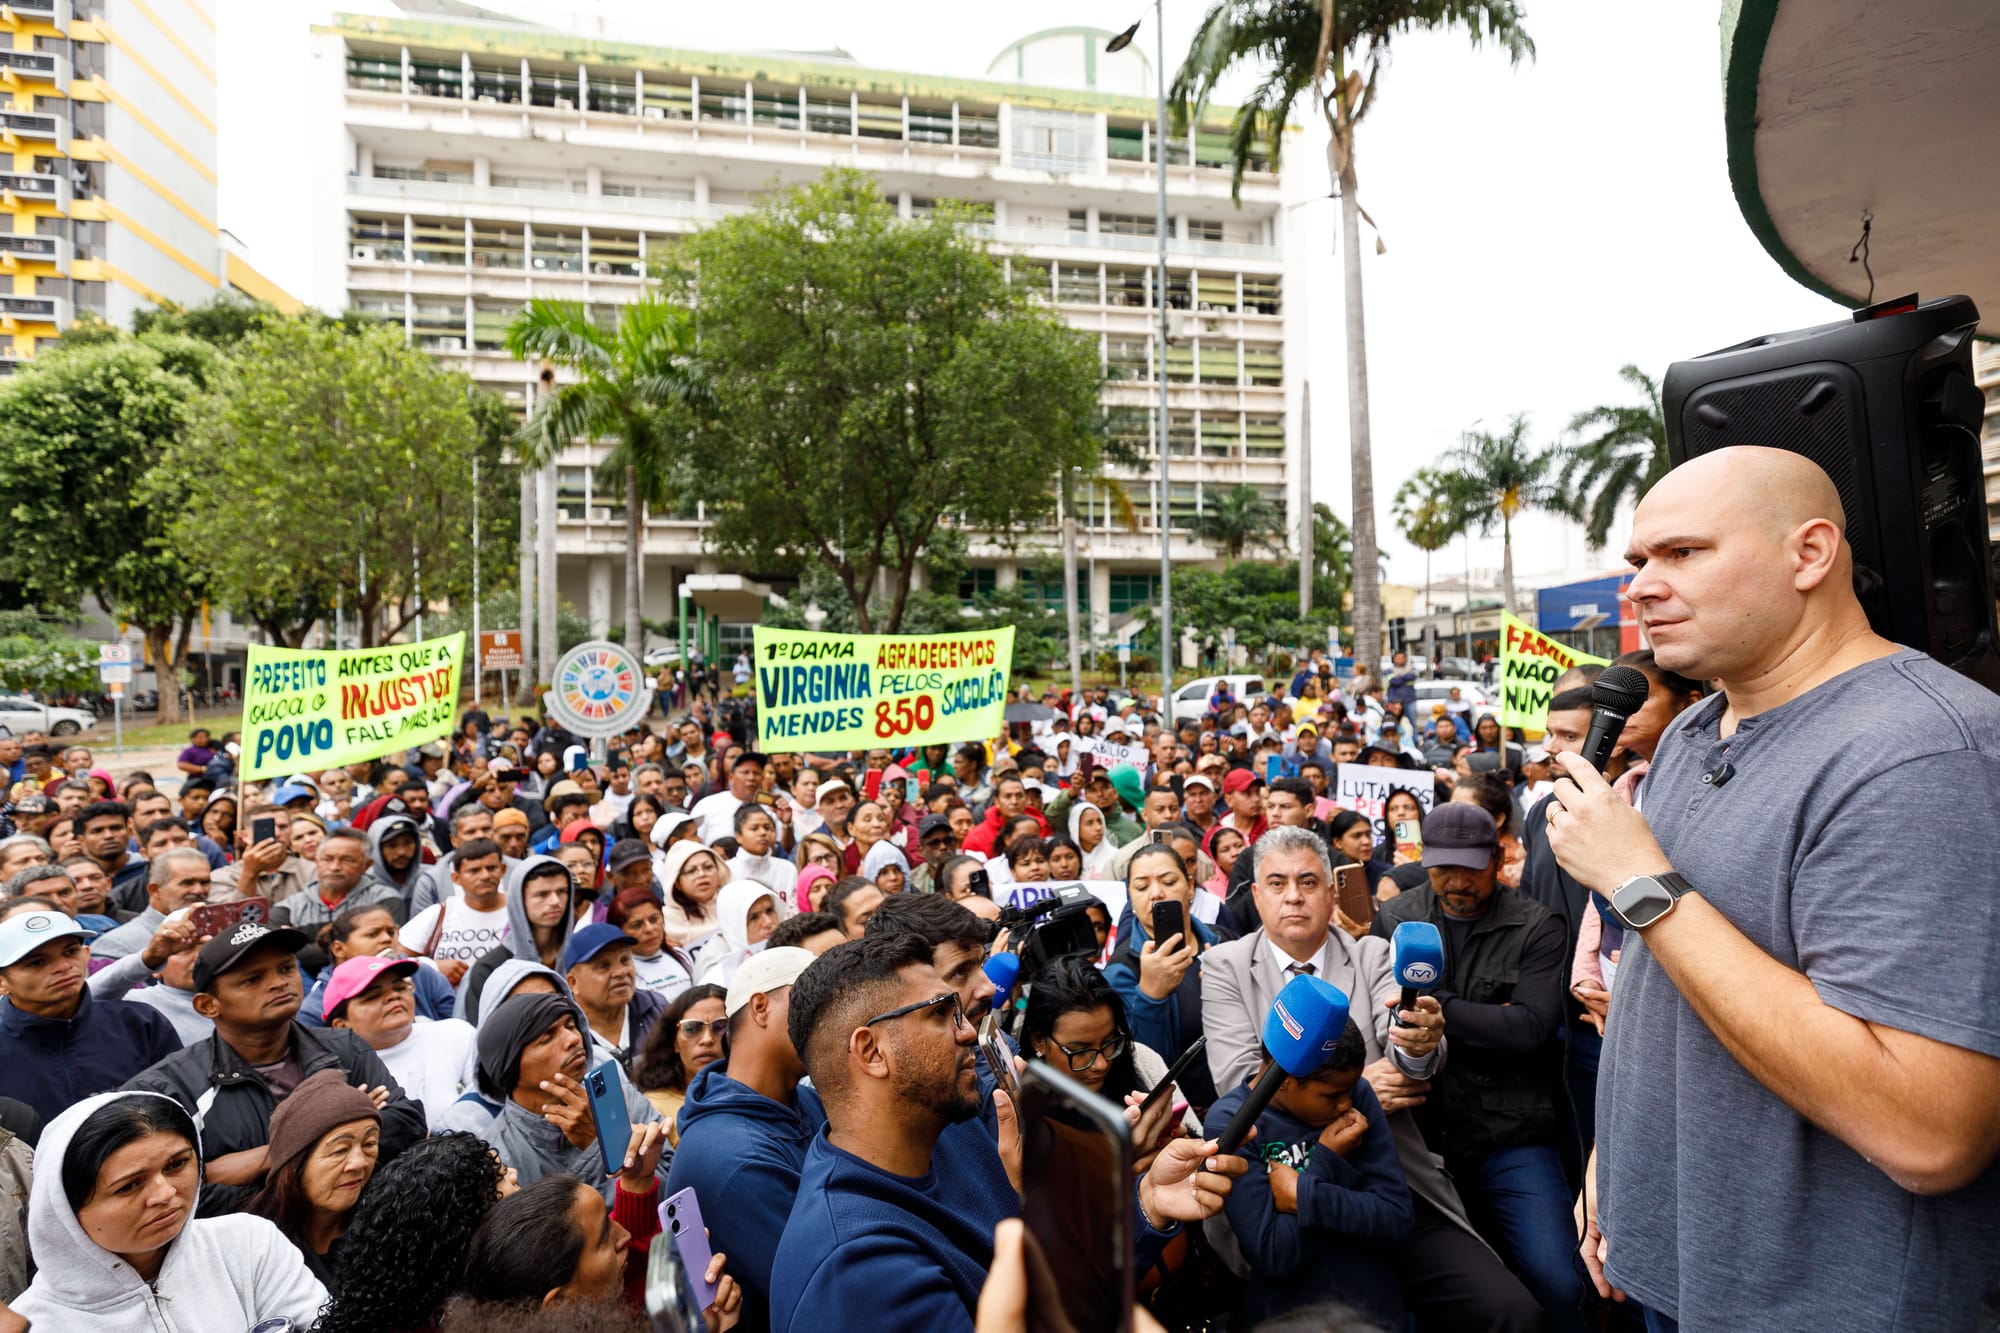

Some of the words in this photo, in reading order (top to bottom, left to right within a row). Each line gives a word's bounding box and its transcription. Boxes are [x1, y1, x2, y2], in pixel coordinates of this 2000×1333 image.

[338, 654, 394, 678] ANTES
[400, 648, 432, 672] QUE
[438, 645, 452, 661] A
[790, 641, 854, 660] DAMA
[876, 639, 995, 669] AGRADECEMOS
[253, 658, 326, 694] PREFEITO
[760, 663, 872, 709] VIRGINIA
[879, 673, 943, 694] PELOS
[1506, 659, 1559, 684] NÃO
[765, 707, 864, 740] MENDES
[874, 695, 935, 738] 850
[254, 718, 334, 769] POVO
[346, 720, 394, 745] FALE
[1410, 968, 1432, 979] TVR
